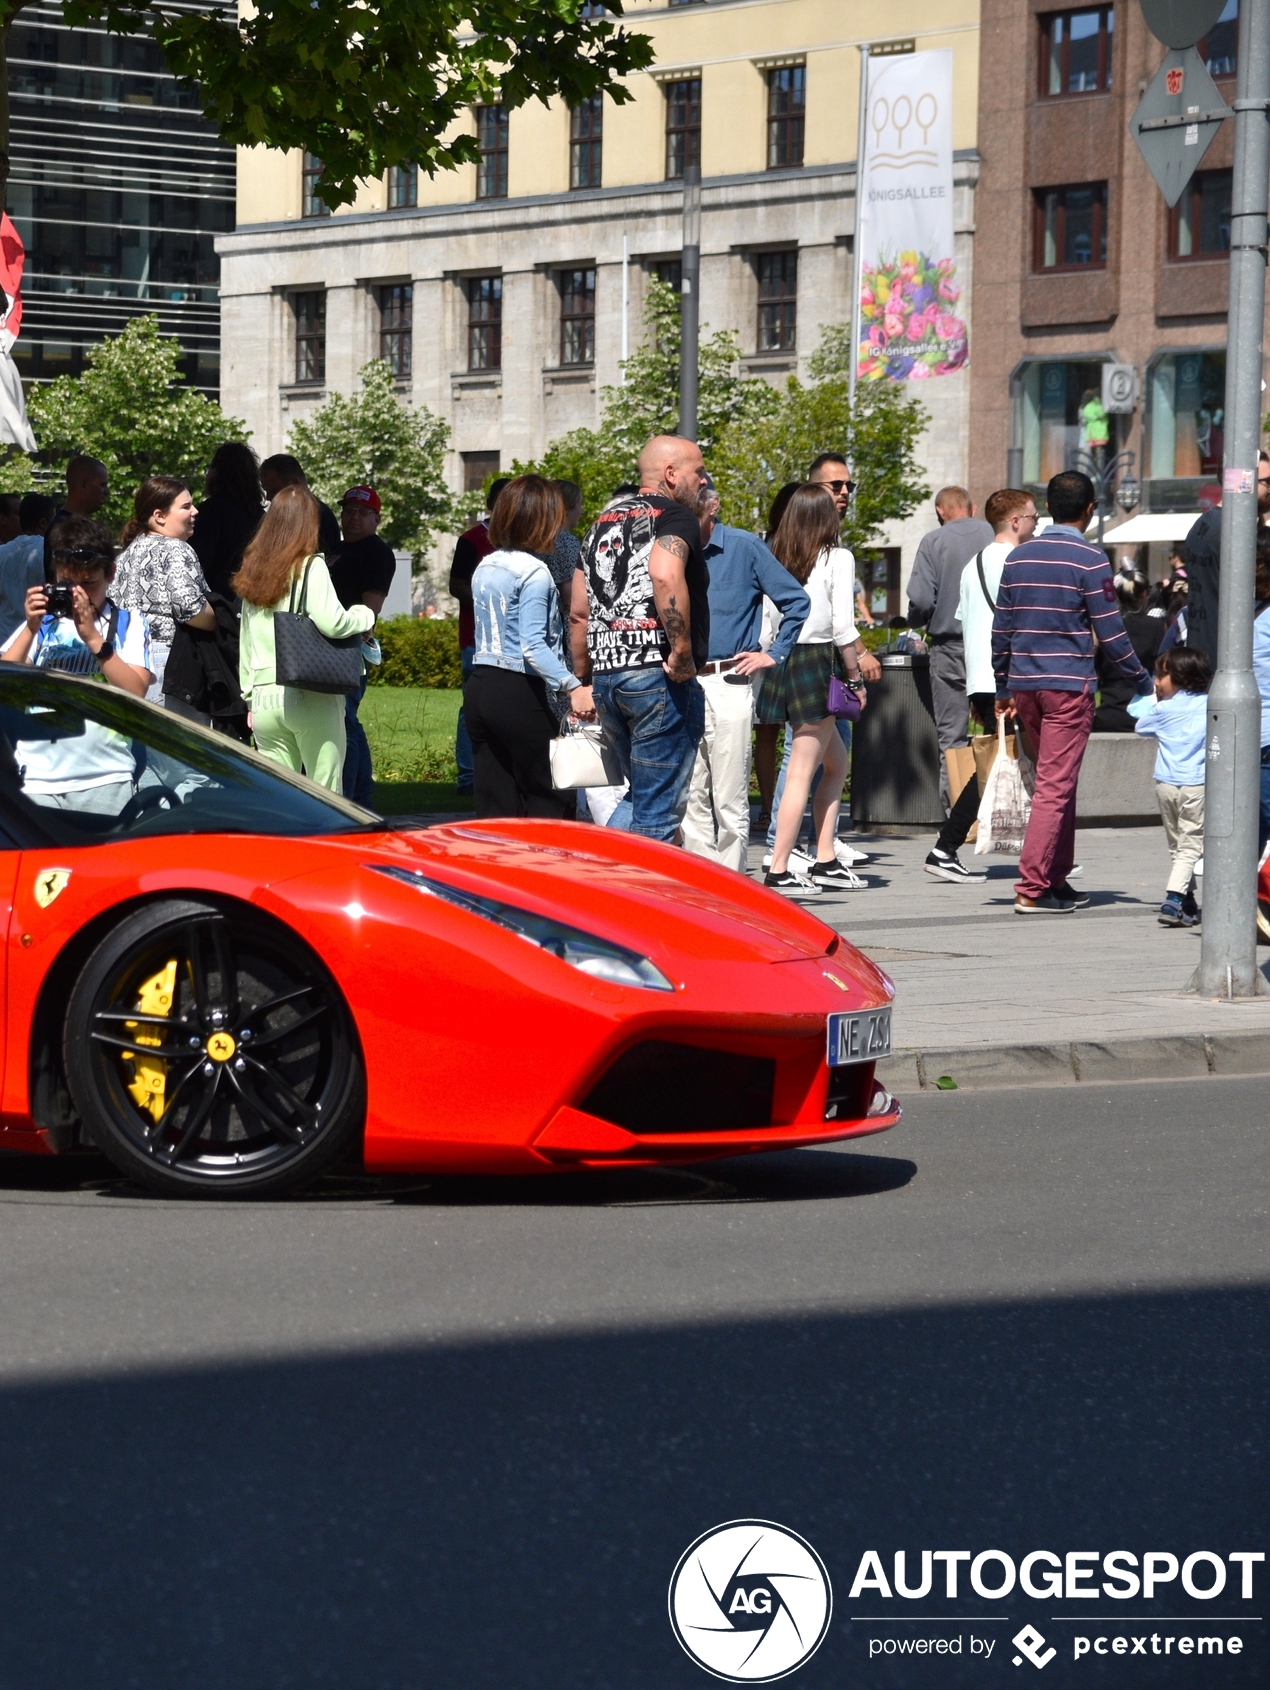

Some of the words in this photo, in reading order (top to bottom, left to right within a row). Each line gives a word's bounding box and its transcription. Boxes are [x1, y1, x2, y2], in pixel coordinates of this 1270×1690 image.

[881, 343, 938, 357] Königsallee
[596, 630, 623, 649] HAVE
[626, 629, 666, 646] TIME
[838, 1018, 860, 1059] NE
